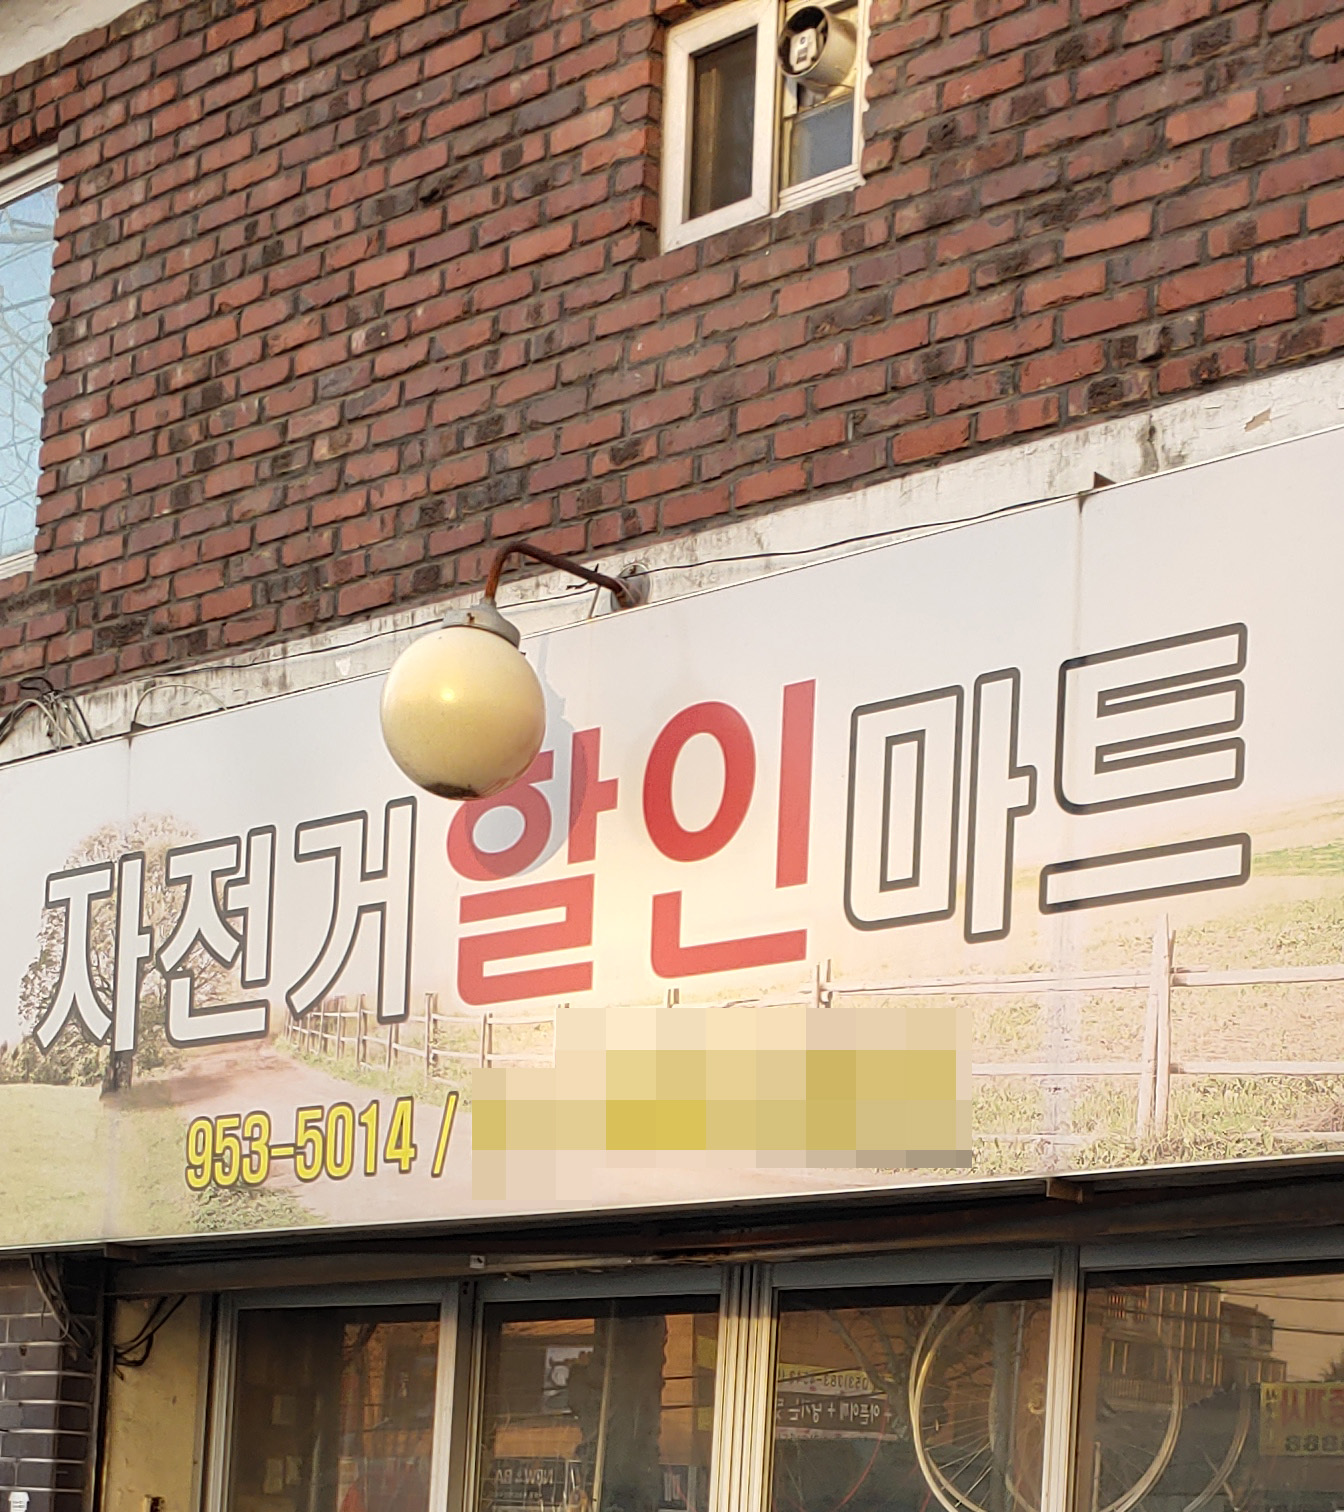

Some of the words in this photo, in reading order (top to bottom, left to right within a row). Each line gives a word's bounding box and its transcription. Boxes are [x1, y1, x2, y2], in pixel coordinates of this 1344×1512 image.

[35, 796, 419, 1054] 자전거
[446, 678, 818, 1007] 할인
[842, 621, 1252, 945] 마트
[184, 1095, 418, 1192] 953-5014
